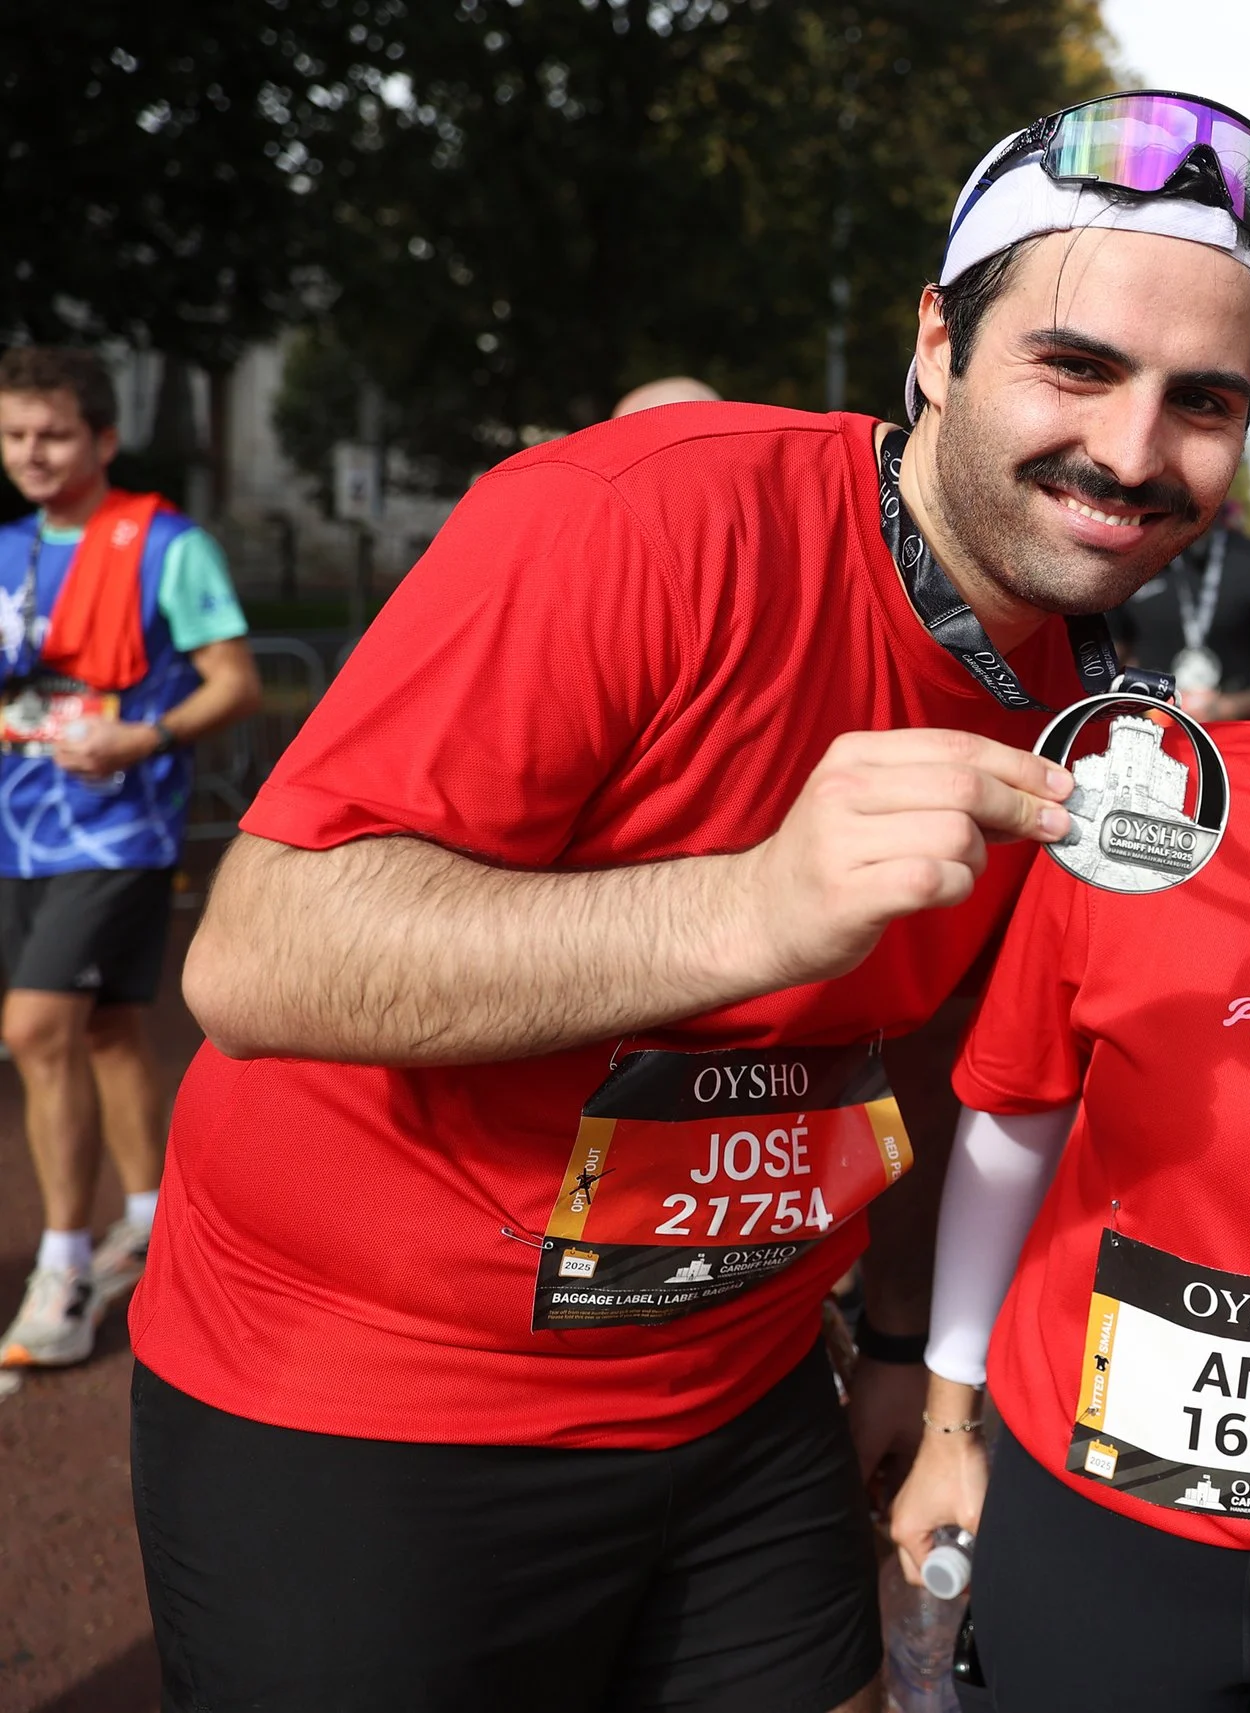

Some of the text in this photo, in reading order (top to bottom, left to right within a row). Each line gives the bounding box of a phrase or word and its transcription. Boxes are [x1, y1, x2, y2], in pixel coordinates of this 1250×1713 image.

[974, 652, 1029, 705] OYSHO
[1155, 678, 1169, 698] 025
[1111, 817, 1197, 851] OYSHO
[1109, 837, 1193, 862] CARDIFF HALF 2025
[693, 1063, 809, 1102] OYSHO
[690, 1114, 811, 1184] JOSÉ
[883, 1136, 902, 1184] RED PE
[571, 1148, 601, 1212] OPT OUT
[655, 1186, 834, 1237] 21754
[564, 1261, 591, 1271] 2025
[720, 1262, 762, 1274] CARDIFF
[763, 1257, 788, 1267] HALF
[723, 1246, 797, 1265] OYSHO
[552, 1293, 614, 1305] BAGGAGE
[616, 1294, 655, 1305] LABEL
[664, 1291, 699, 1304] LABEL
[1099, 1312, 1114, 1354] SMALL
[1090, 1456, 1112, 1471] 2025
[1229, 1506, 1250, 1514] HANNER
